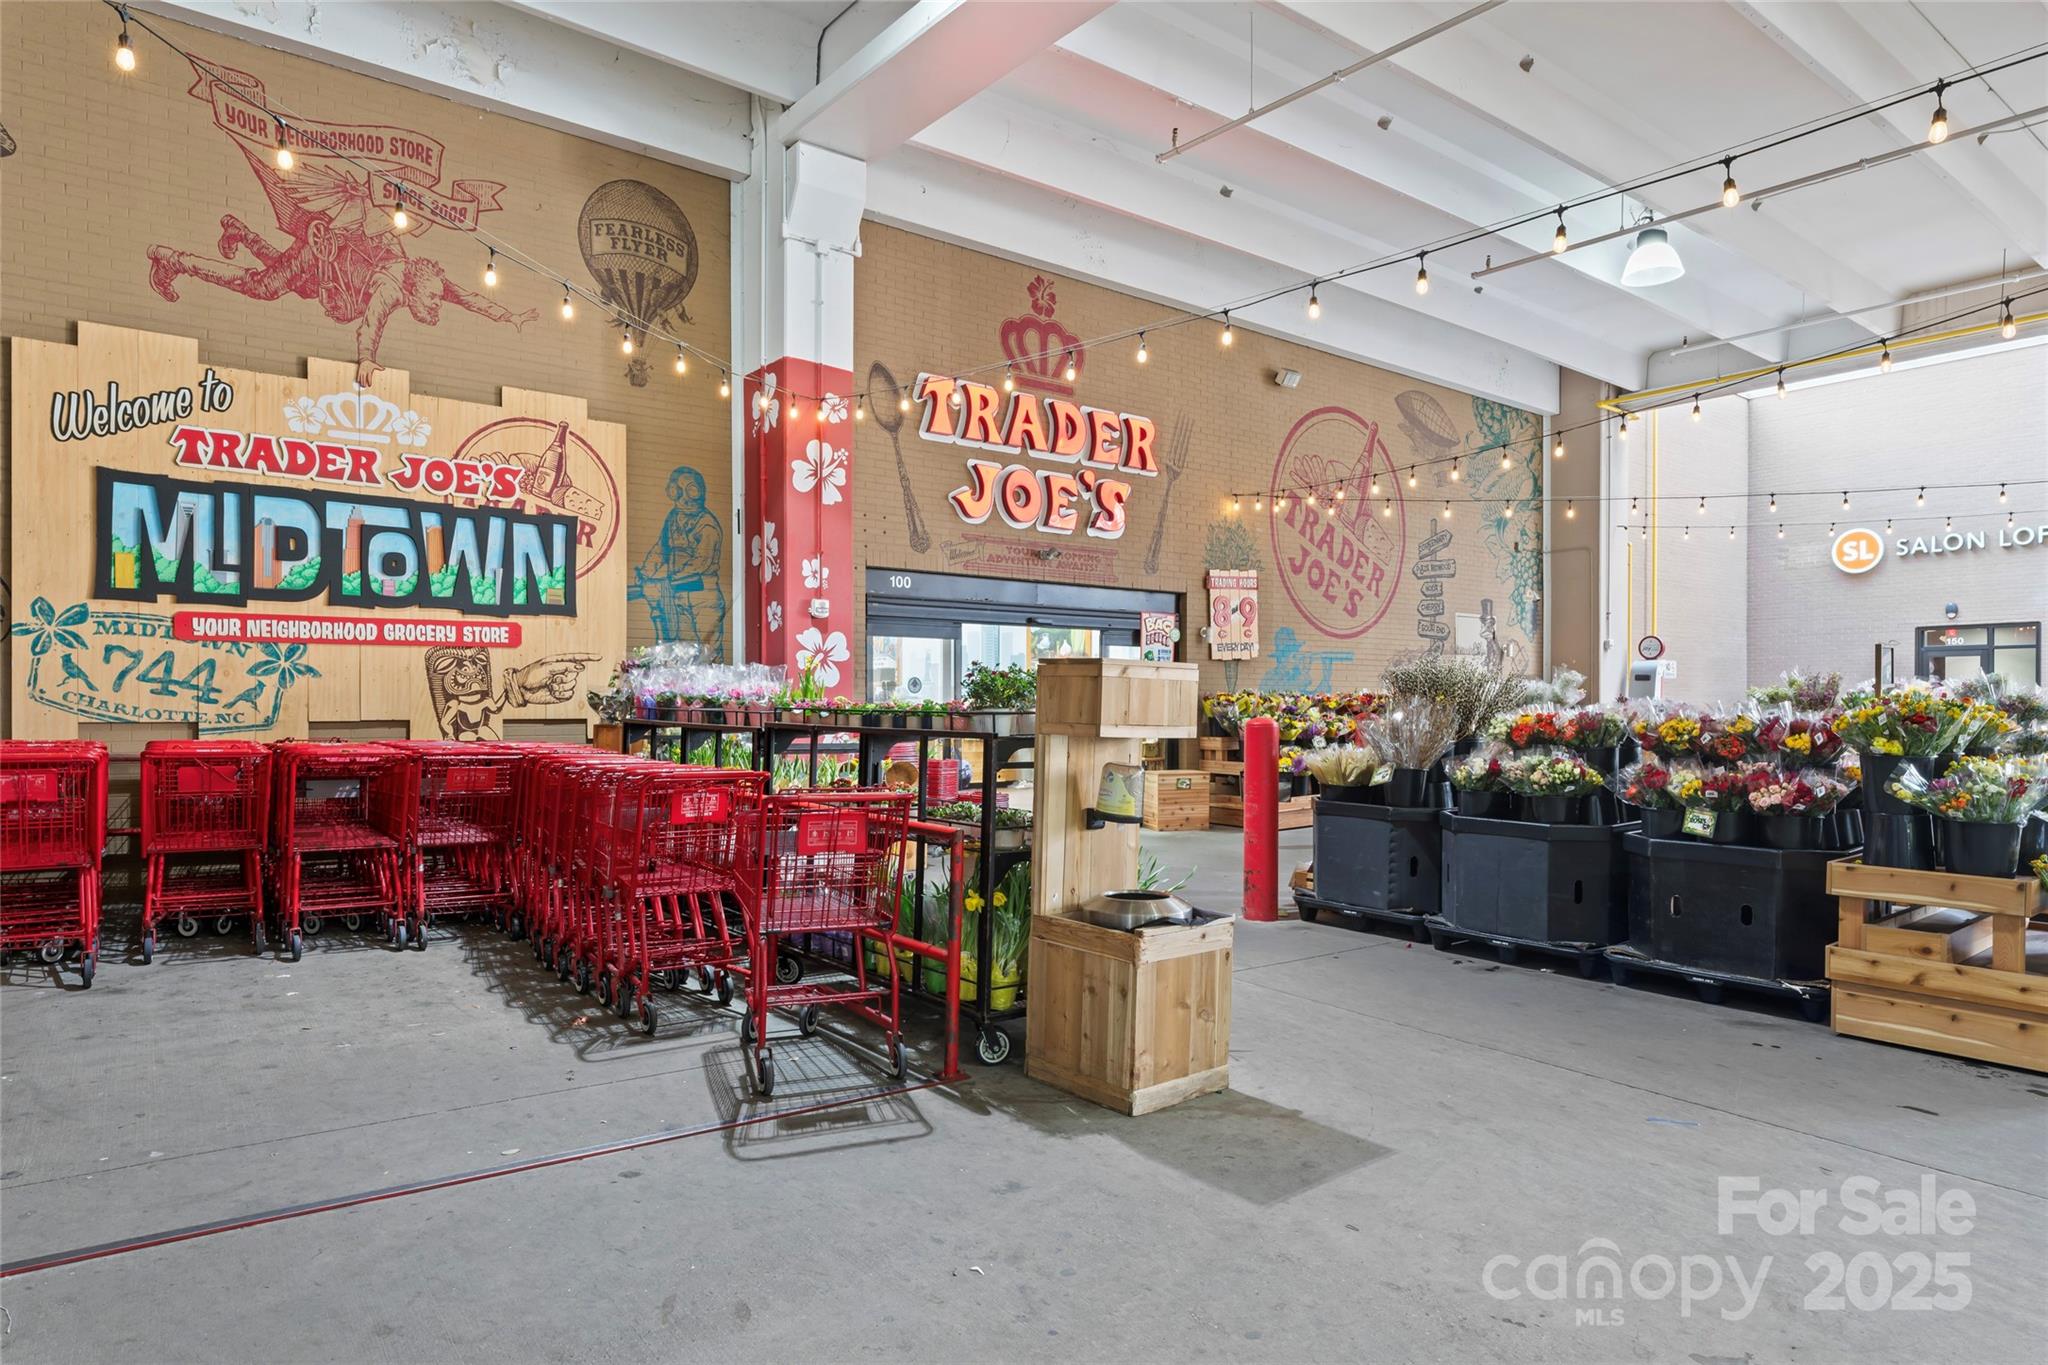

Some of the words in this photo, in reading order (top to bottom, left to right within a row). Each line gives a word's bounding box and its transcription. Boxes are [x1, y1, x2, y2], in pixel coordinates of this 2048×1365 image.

[225, 103, 268, 137] YOUR
[274, 123, 385, 155] NEIGHBORHOOD
[389, 136, 433, 167] STORE
[594, 222, 686, 258] FEARLESS
[610, 236, 669, 263] FLYER
[51, 381, 193, 441] Welcome
[199, 368, 234, 412] to
[912, 372, 1159, 477] TRADER
[169, 424, 385, 489] TRADER
[387, 453, 525, 502] JOE'S
[948, 458, 1132, 540] JOE'S
[100, 475, 575, 613] MIDTOWN
[1284, 489, 1385, 598] TRADER
[1842, 540, 1874, 562] SL
[1896, 529, 1985, 557] SALON
[889, 575, 911, 589] 100
[1213, 596, 1231, 628] 8
[1239, 597, 1257, 627] 9
[1288, 544, 1365, 618] JOE'S
[192, 616, 241, 637] YOUR
[246, 618, 378, 641] NEIGHBORHOOD
[383, 623, 456, 642] GROCERY
[462, 625, 509, 643] STORE
[103, 644, 222, 704] 744
